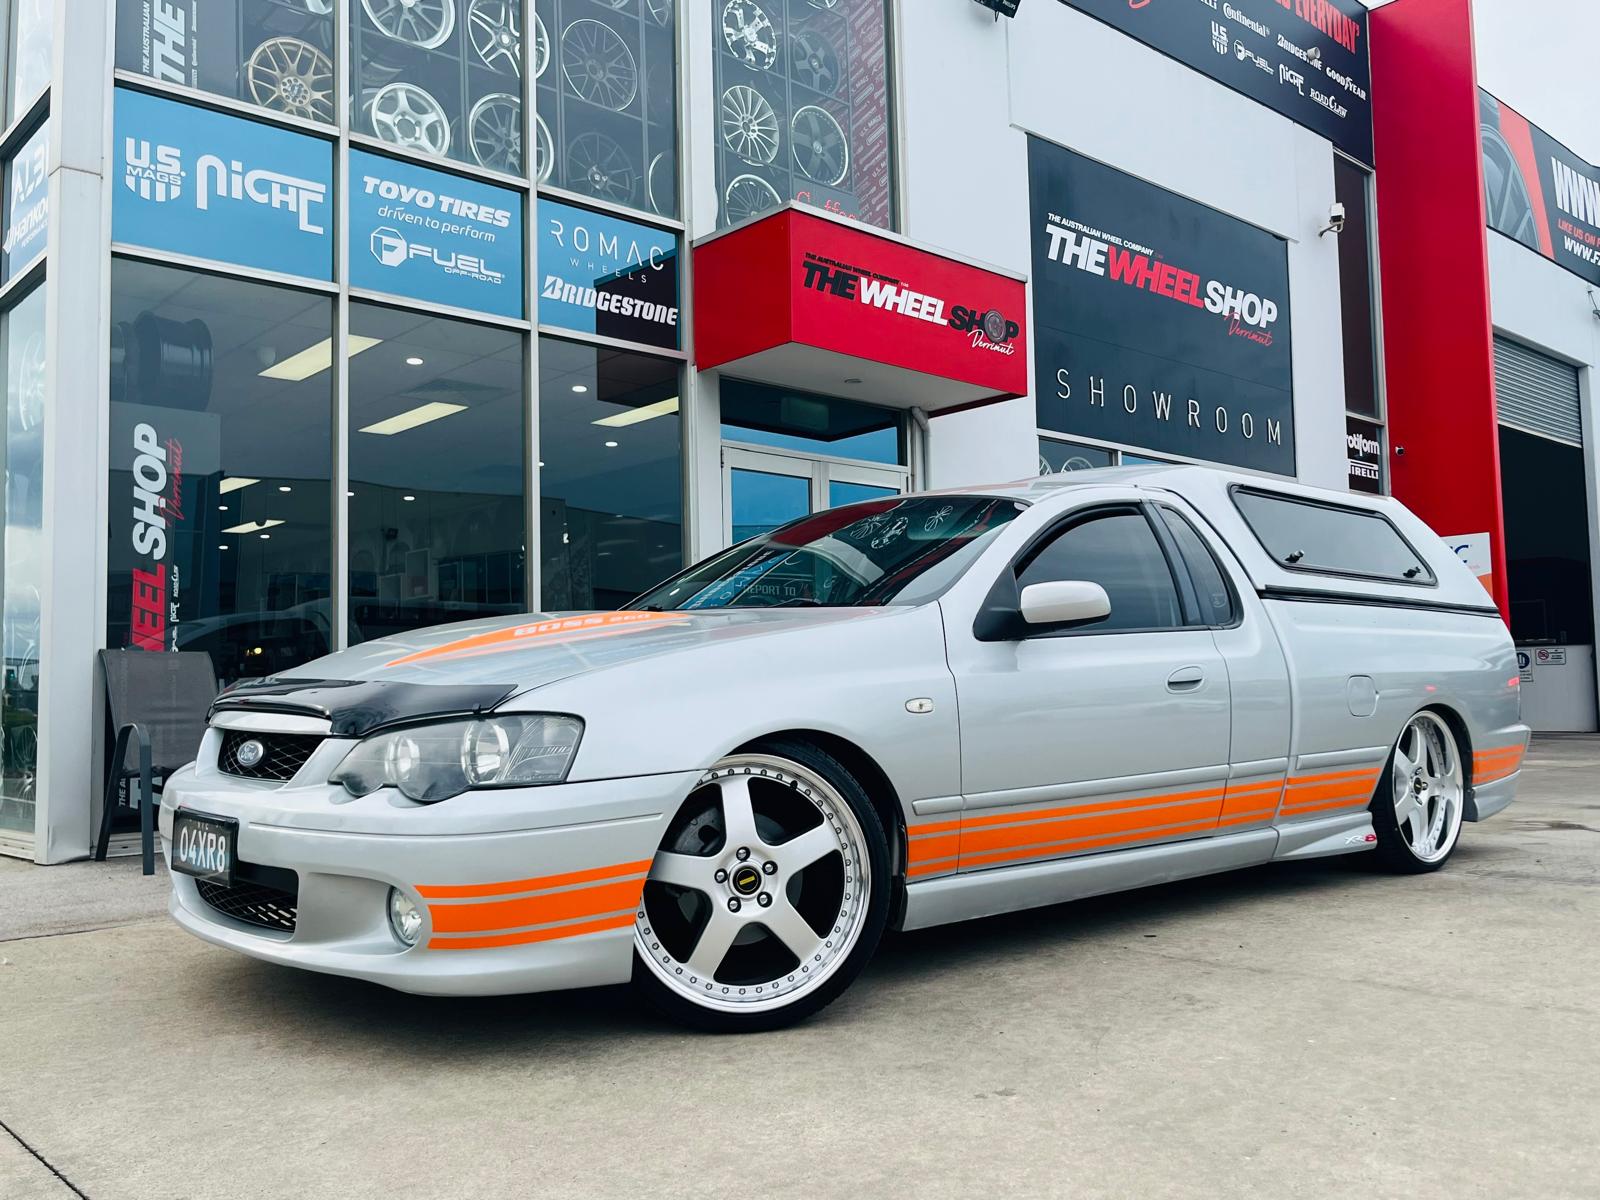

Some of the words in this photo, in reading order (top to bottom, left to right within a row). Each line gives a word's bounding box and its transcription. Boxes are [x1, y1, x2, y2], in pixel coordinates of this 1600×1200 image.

[153, 0, 185, 85] THE
[1223, 3, 1266, 37] Continental
[142, 56, 150, 74] THE
[363, 175, 435, 208] TOYO
[438, 194, 511, 228] TIRES
[378, 205, 423, 225] driven
[425, 216, 440, 229] to
[441, 222, 495, 243] perform
[550, 219, 664, 271] ROMAC
[1048, 212, 1061, 223] THE
[1061, 217, 1101, 238] AUSTRALIAN
[1101, 231, 1122, 246] WHEEL
[1123, 240, 1154, 256] COMPANY
[1558, 218, 1573, 235] LIKE
[1573, 227, 1584, 240] US
[1584, 233, 1596, 246] ON
[408, 243, 502, 278] FUEL
[444, 267, 502, 284] OFF-ROAD
[570, 257, 647, 283] WHEELS
[1045, 223, 1109, 276] THE
[1108, 244, 1204, 309] WHEEL
[1204, 280, 1278, 329] SHOP
[541, 275, 678, 326] BRIDGESTONE
[802, 260, 858, 300] THE
[860, 276, 948, 326] WHEEL
[948, 305, 1019, 344] SHOP
[967, 329, 1014, 355] Derrimut
[1056, 368, 1281, 445] SHOWROOM
[132, 422, 167, 560] SHOP
[180, 825, 226, 873] 04XR8
